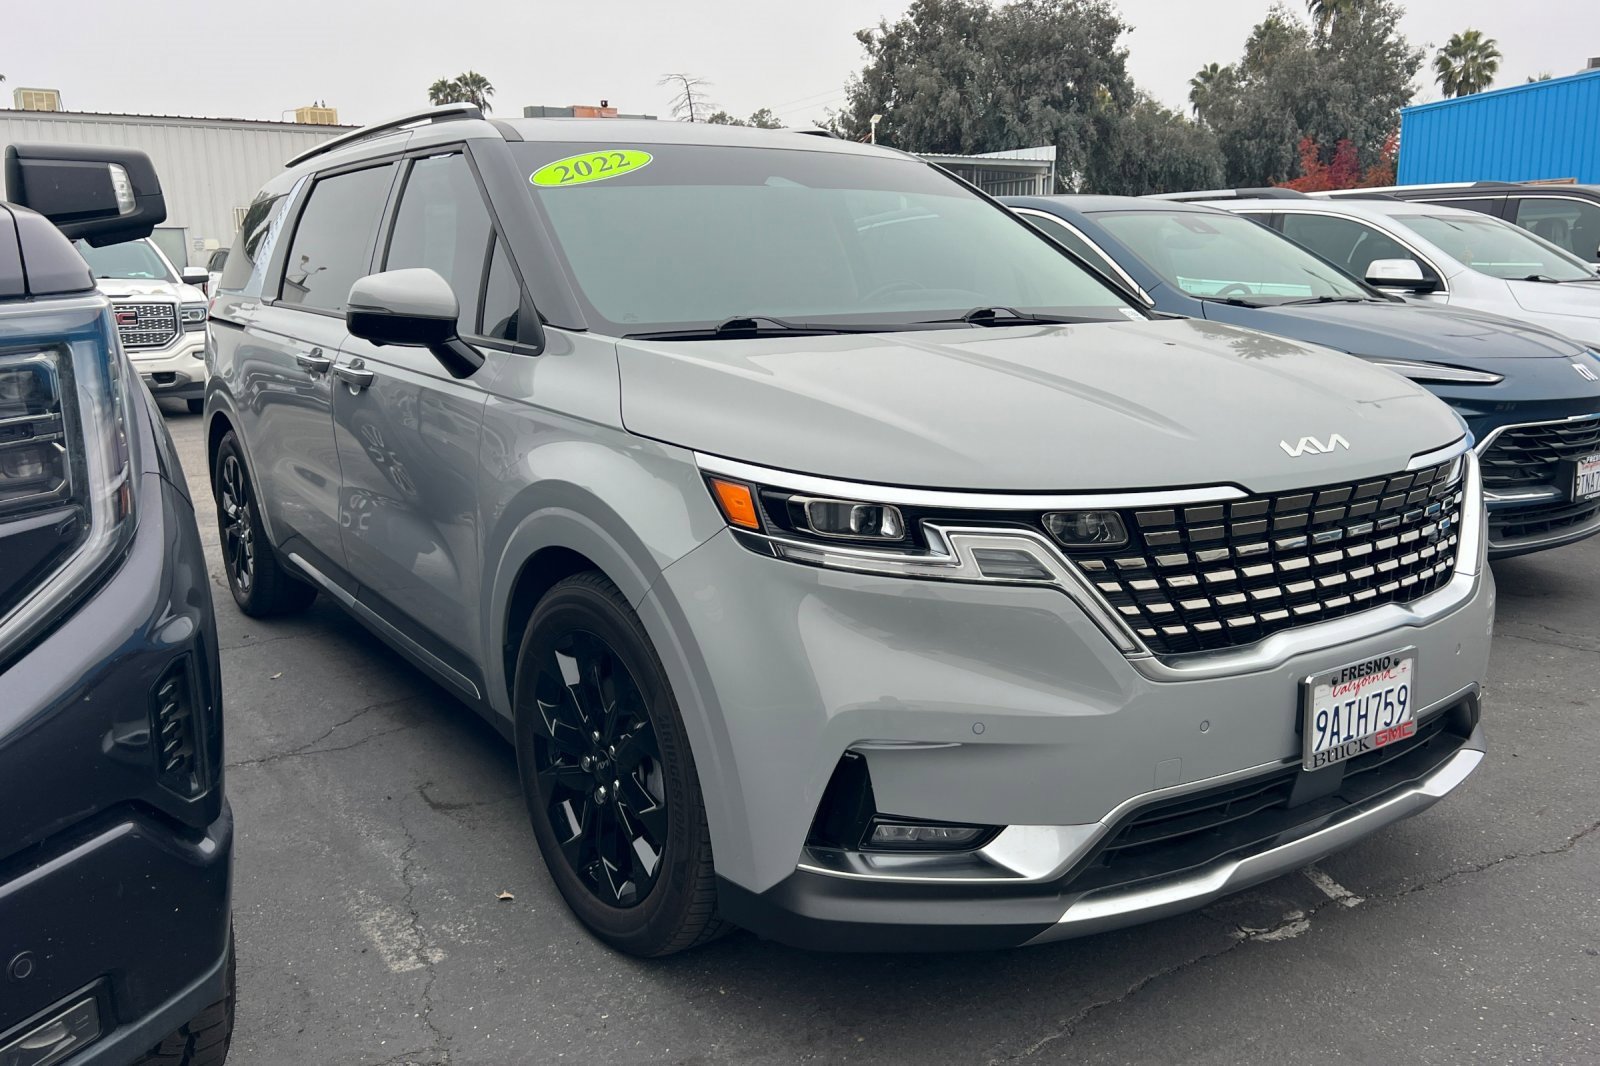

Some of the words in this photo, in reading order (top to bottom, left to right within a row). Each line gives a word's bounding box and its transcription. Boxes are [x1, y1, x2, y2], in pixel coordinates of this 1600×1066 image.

[554, 152, 631, 184] 2022
[1332, 669, 1397, 698] California
[1341, 656, 1391, 683] FRESNO
[1315, 684, 1408, 752] 9AIH759
[1314, 738, 1371, 768] BUICK
[1375, 721, 1413, 747] GMC
